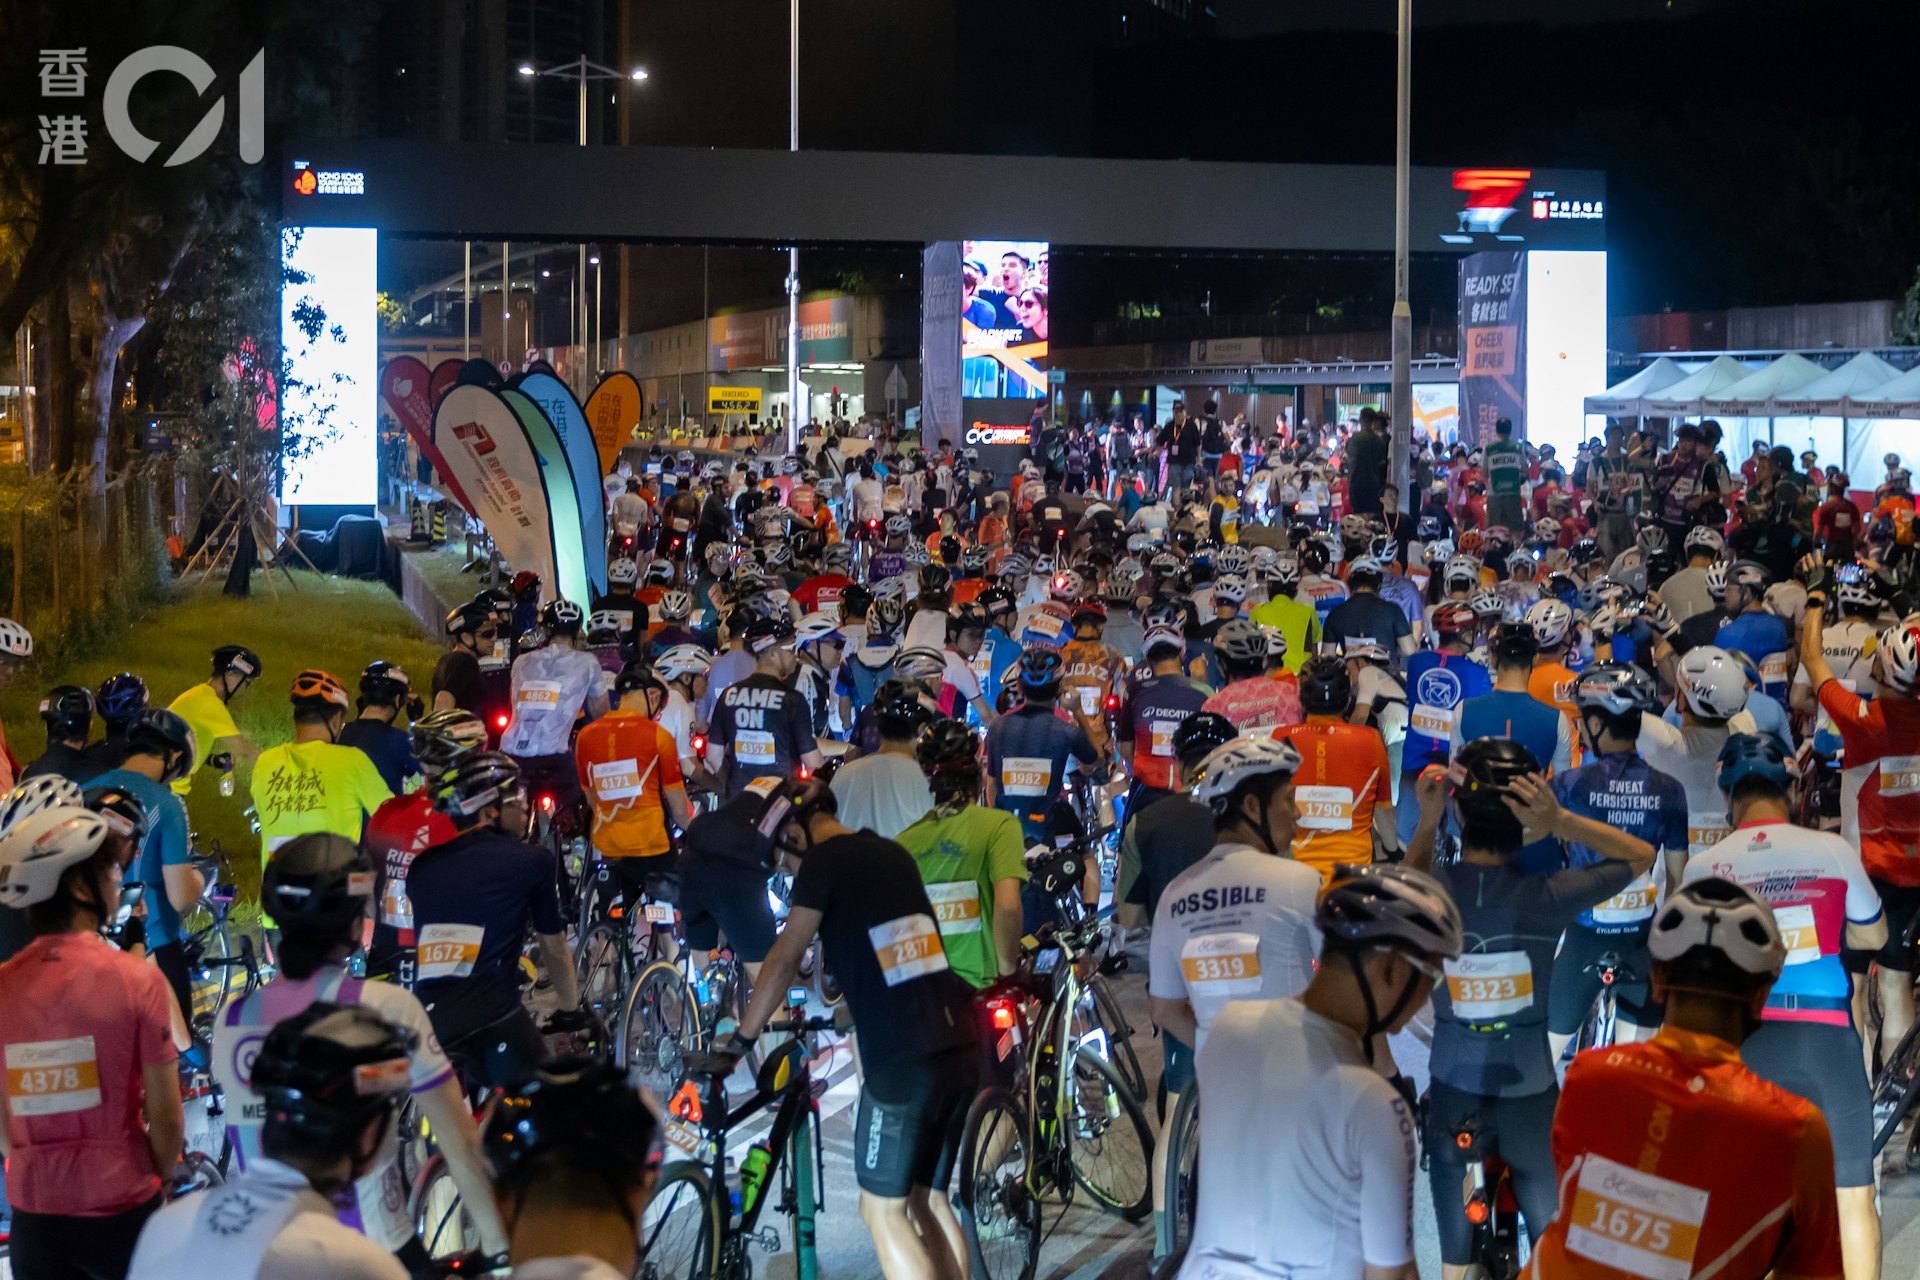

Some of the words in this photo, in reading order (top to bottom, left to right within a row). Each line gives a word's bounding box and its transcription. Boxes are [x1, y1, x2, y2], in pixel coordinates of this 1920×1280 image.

[725, 687, 786, 711] GAME
[735, 707, 765, 729] ON
[601, 775, 631, 790] 4171
[1009, 772, 1041, 785] 3982
[1609, 779, 1644, 794] SWEAT
[1306, 803, 1342, 817] 1790
[1589, 792, 1660, 811] PERSISTENCE
[1607, 810, 1645, 825] HONOR
[1171, 886, 1266, 919] POSSIBLE
[1607, 892, 1647, 910] 1791
[425, 944, 464, 962] 1672
[1195, 957, 1244, 979] 3319
[1459, 977, 1517, 1000] 3323
[20, 1067, 79, 1093] 4378
[666, 1124, 699, 1149] 2877
[1590, 1200, 1671, 1251] 1675
